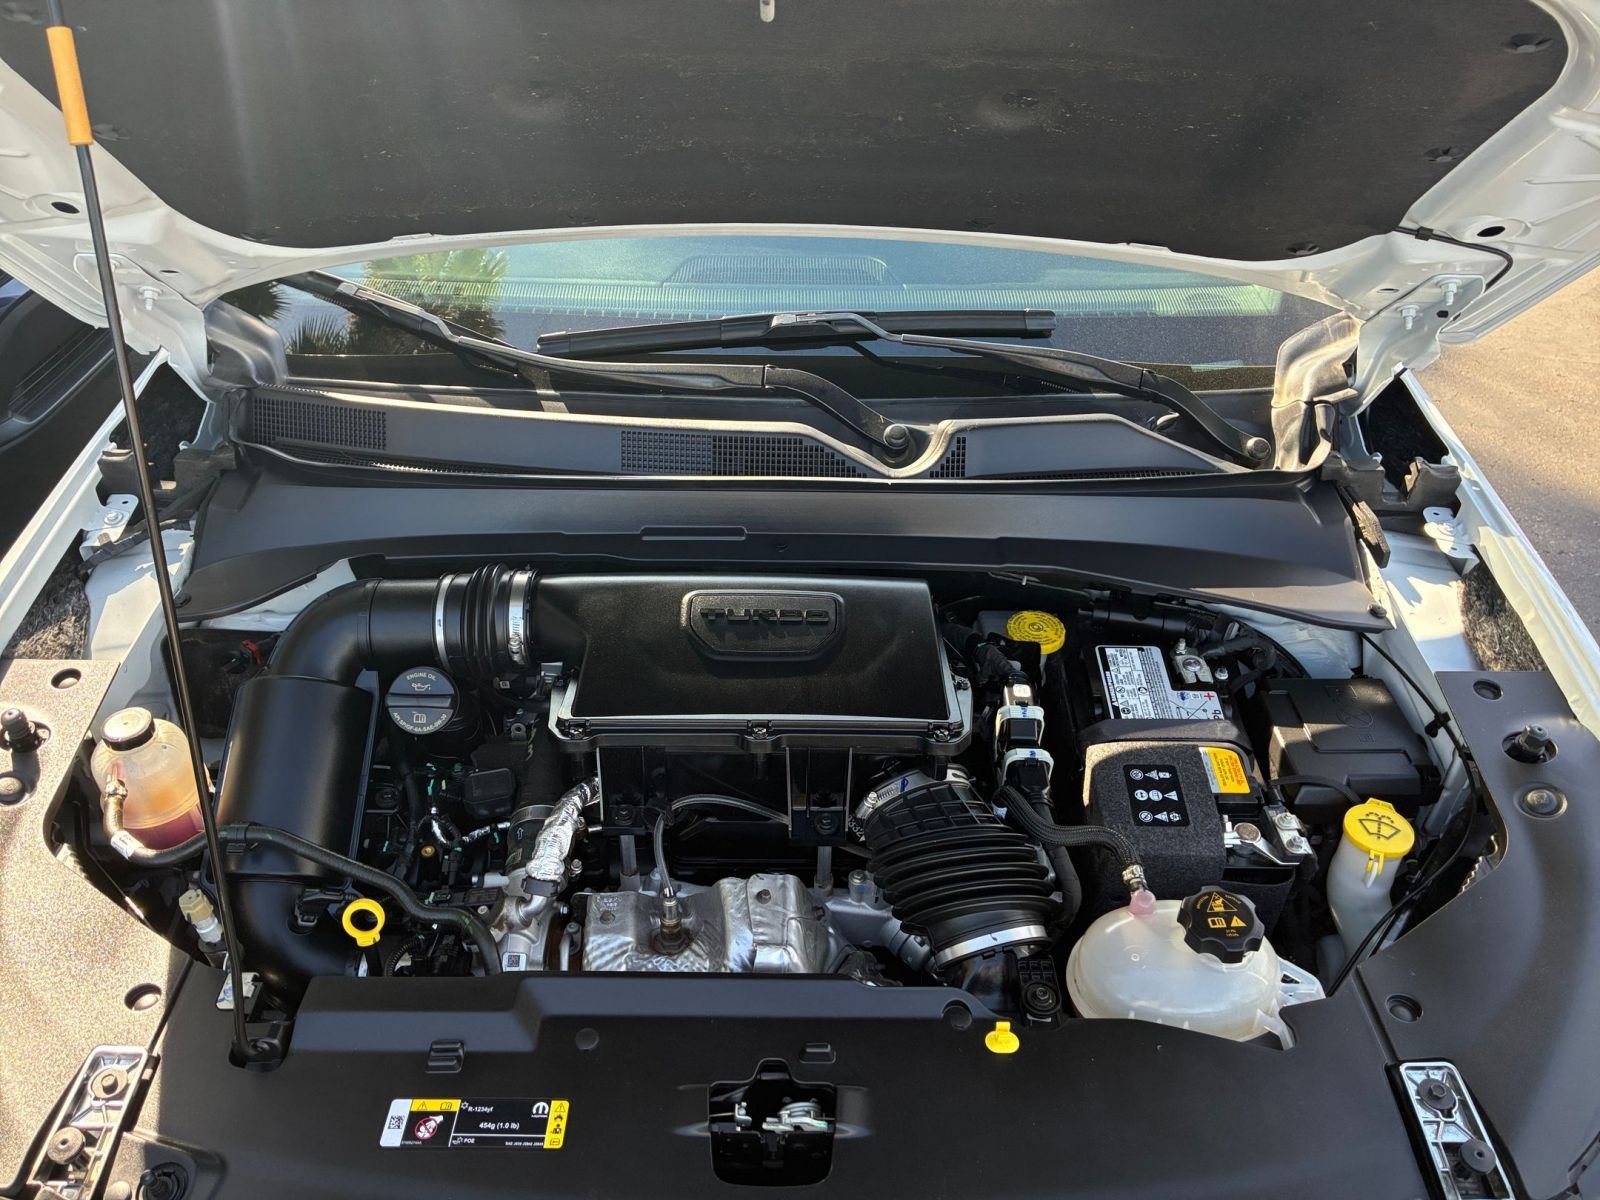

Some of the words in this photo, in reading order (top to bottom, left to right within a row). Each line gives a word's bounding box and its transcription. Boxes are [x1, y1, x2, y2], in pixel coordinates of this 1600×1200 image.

[700, 608, 830, 624] TURBO
[406, 672, 427, 680] ENGINE
[468, 1105, 493, 1113] R-1234yf
[479, 1122, 496, 1130] 454g
[497, 1122, 510, 1130] (1.0
[510, 1122, 520, 1130] lb)
